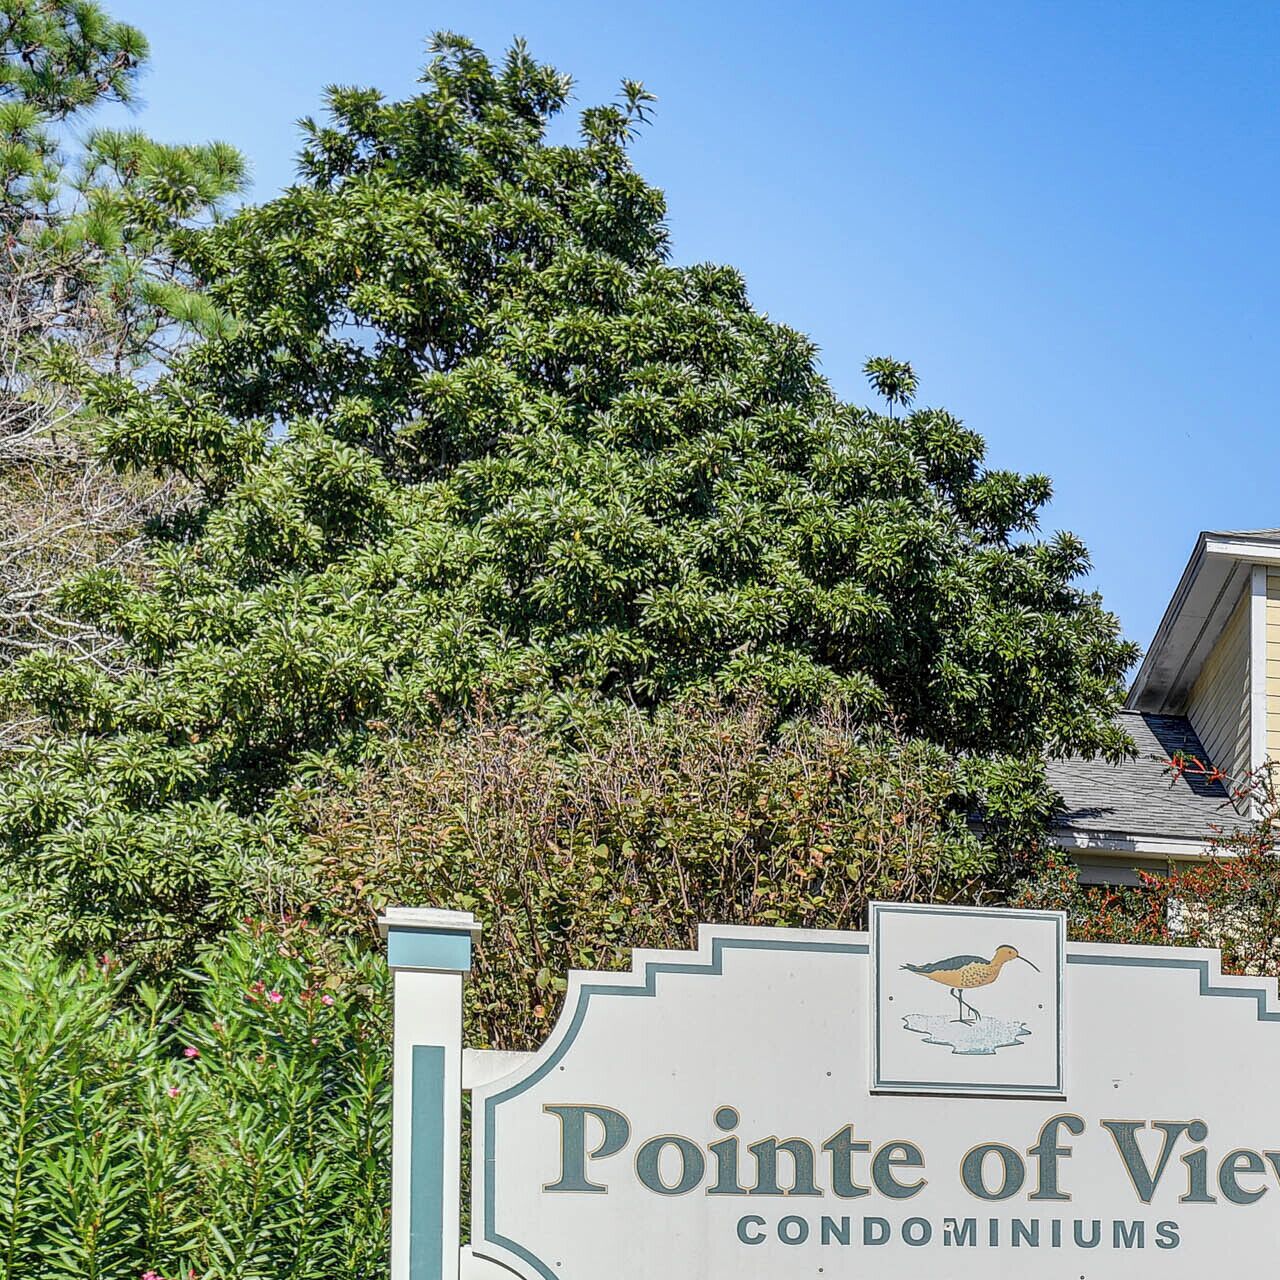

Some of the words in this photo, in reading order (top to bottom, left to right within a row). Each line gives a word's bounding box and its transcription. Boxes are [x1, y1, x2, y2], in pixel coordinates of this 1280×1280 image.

[541, 1102, 930, 1200] Pointe
[959, 1112, 1087, 1203] of
[735, 1213, 1183, 1250] CONDOMINIUMS
